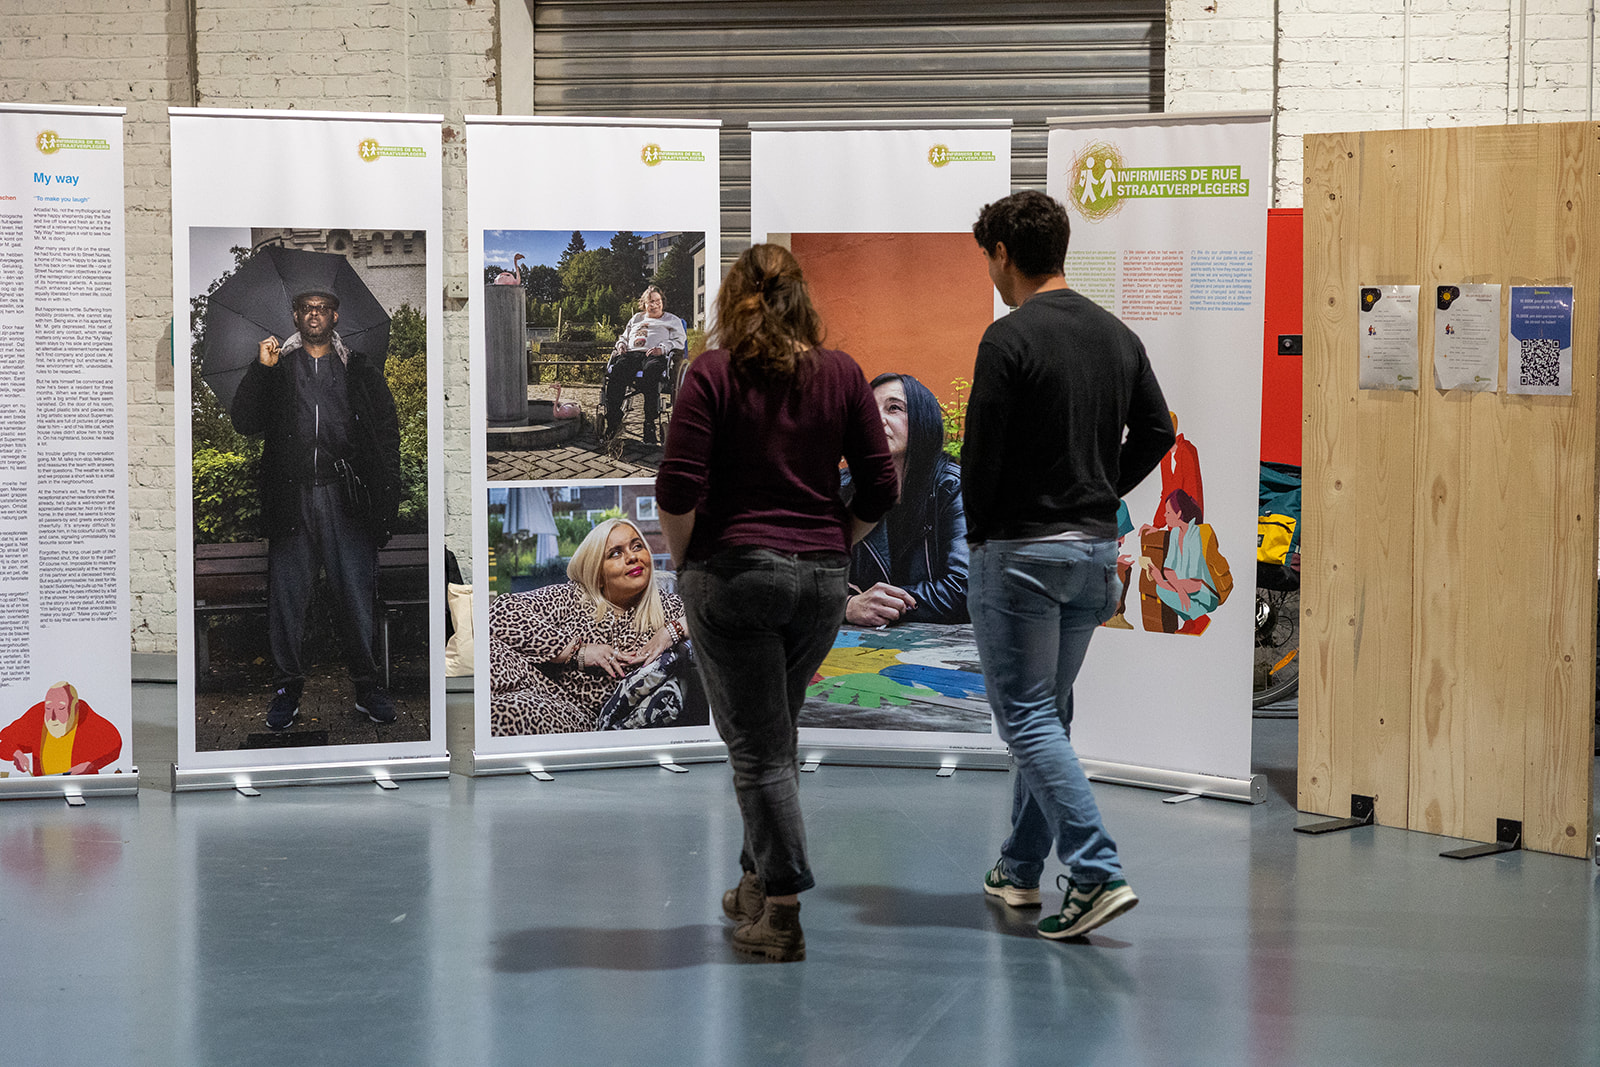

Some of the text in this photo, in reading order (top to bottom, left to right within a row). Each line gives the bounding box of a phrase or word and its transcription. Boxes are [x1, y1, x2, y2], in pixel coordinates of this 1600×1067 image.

[34, 172, 79, 186] My way
[1117, 168, 1237, 182] INFIRMIERS DE RUE
[1117, 182, 1247, 196] STRAATVERPLEGERS
